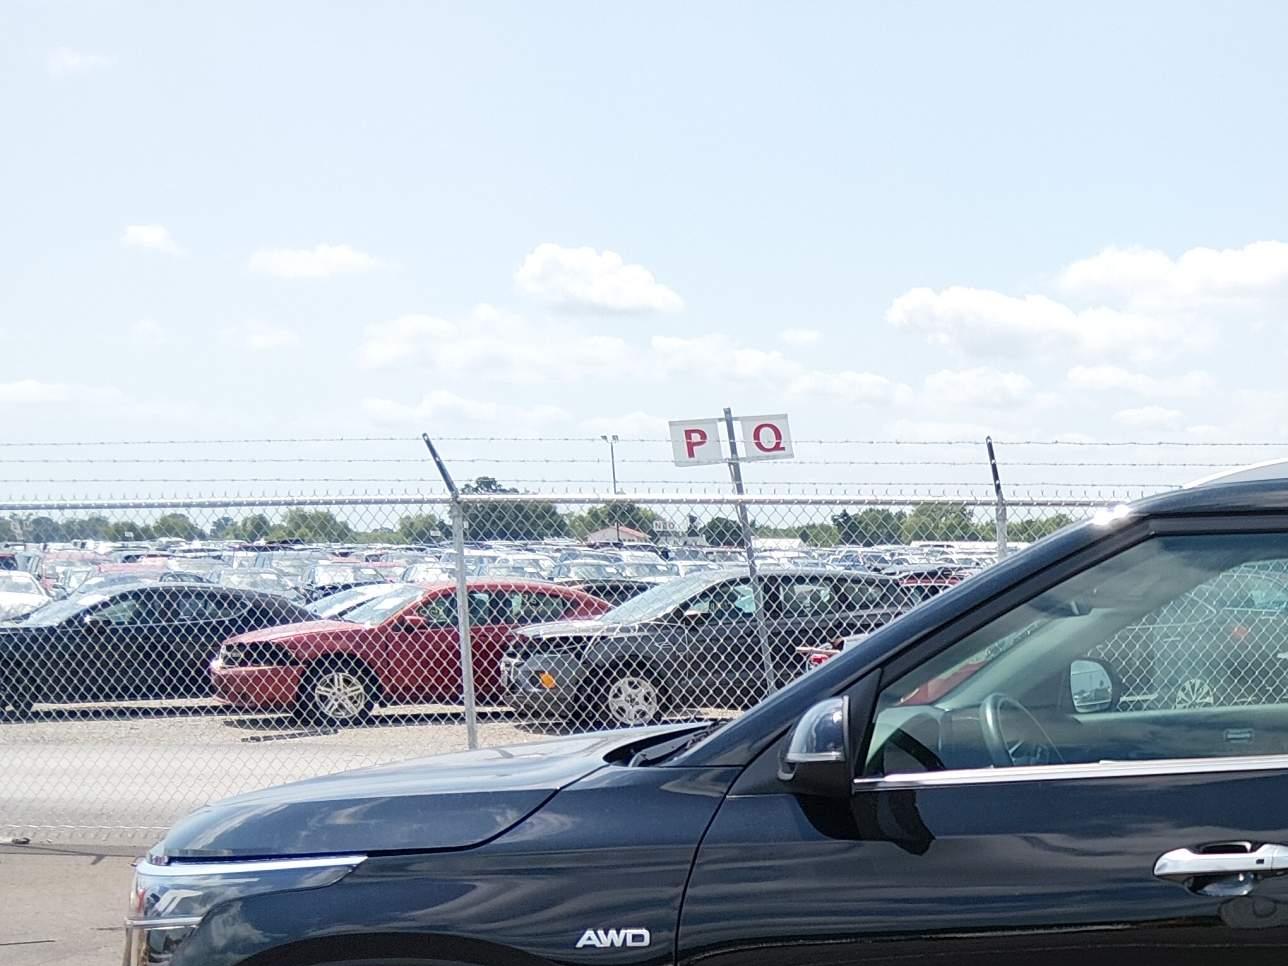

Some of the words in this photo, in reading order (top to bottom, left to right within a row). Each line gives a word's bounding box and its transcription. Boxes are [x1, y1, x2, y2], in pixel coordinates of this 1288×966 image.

[684, 428, 708, 458] P
[753, 423, 786, 452] Q
[575, 928, 651, 948] AWD
